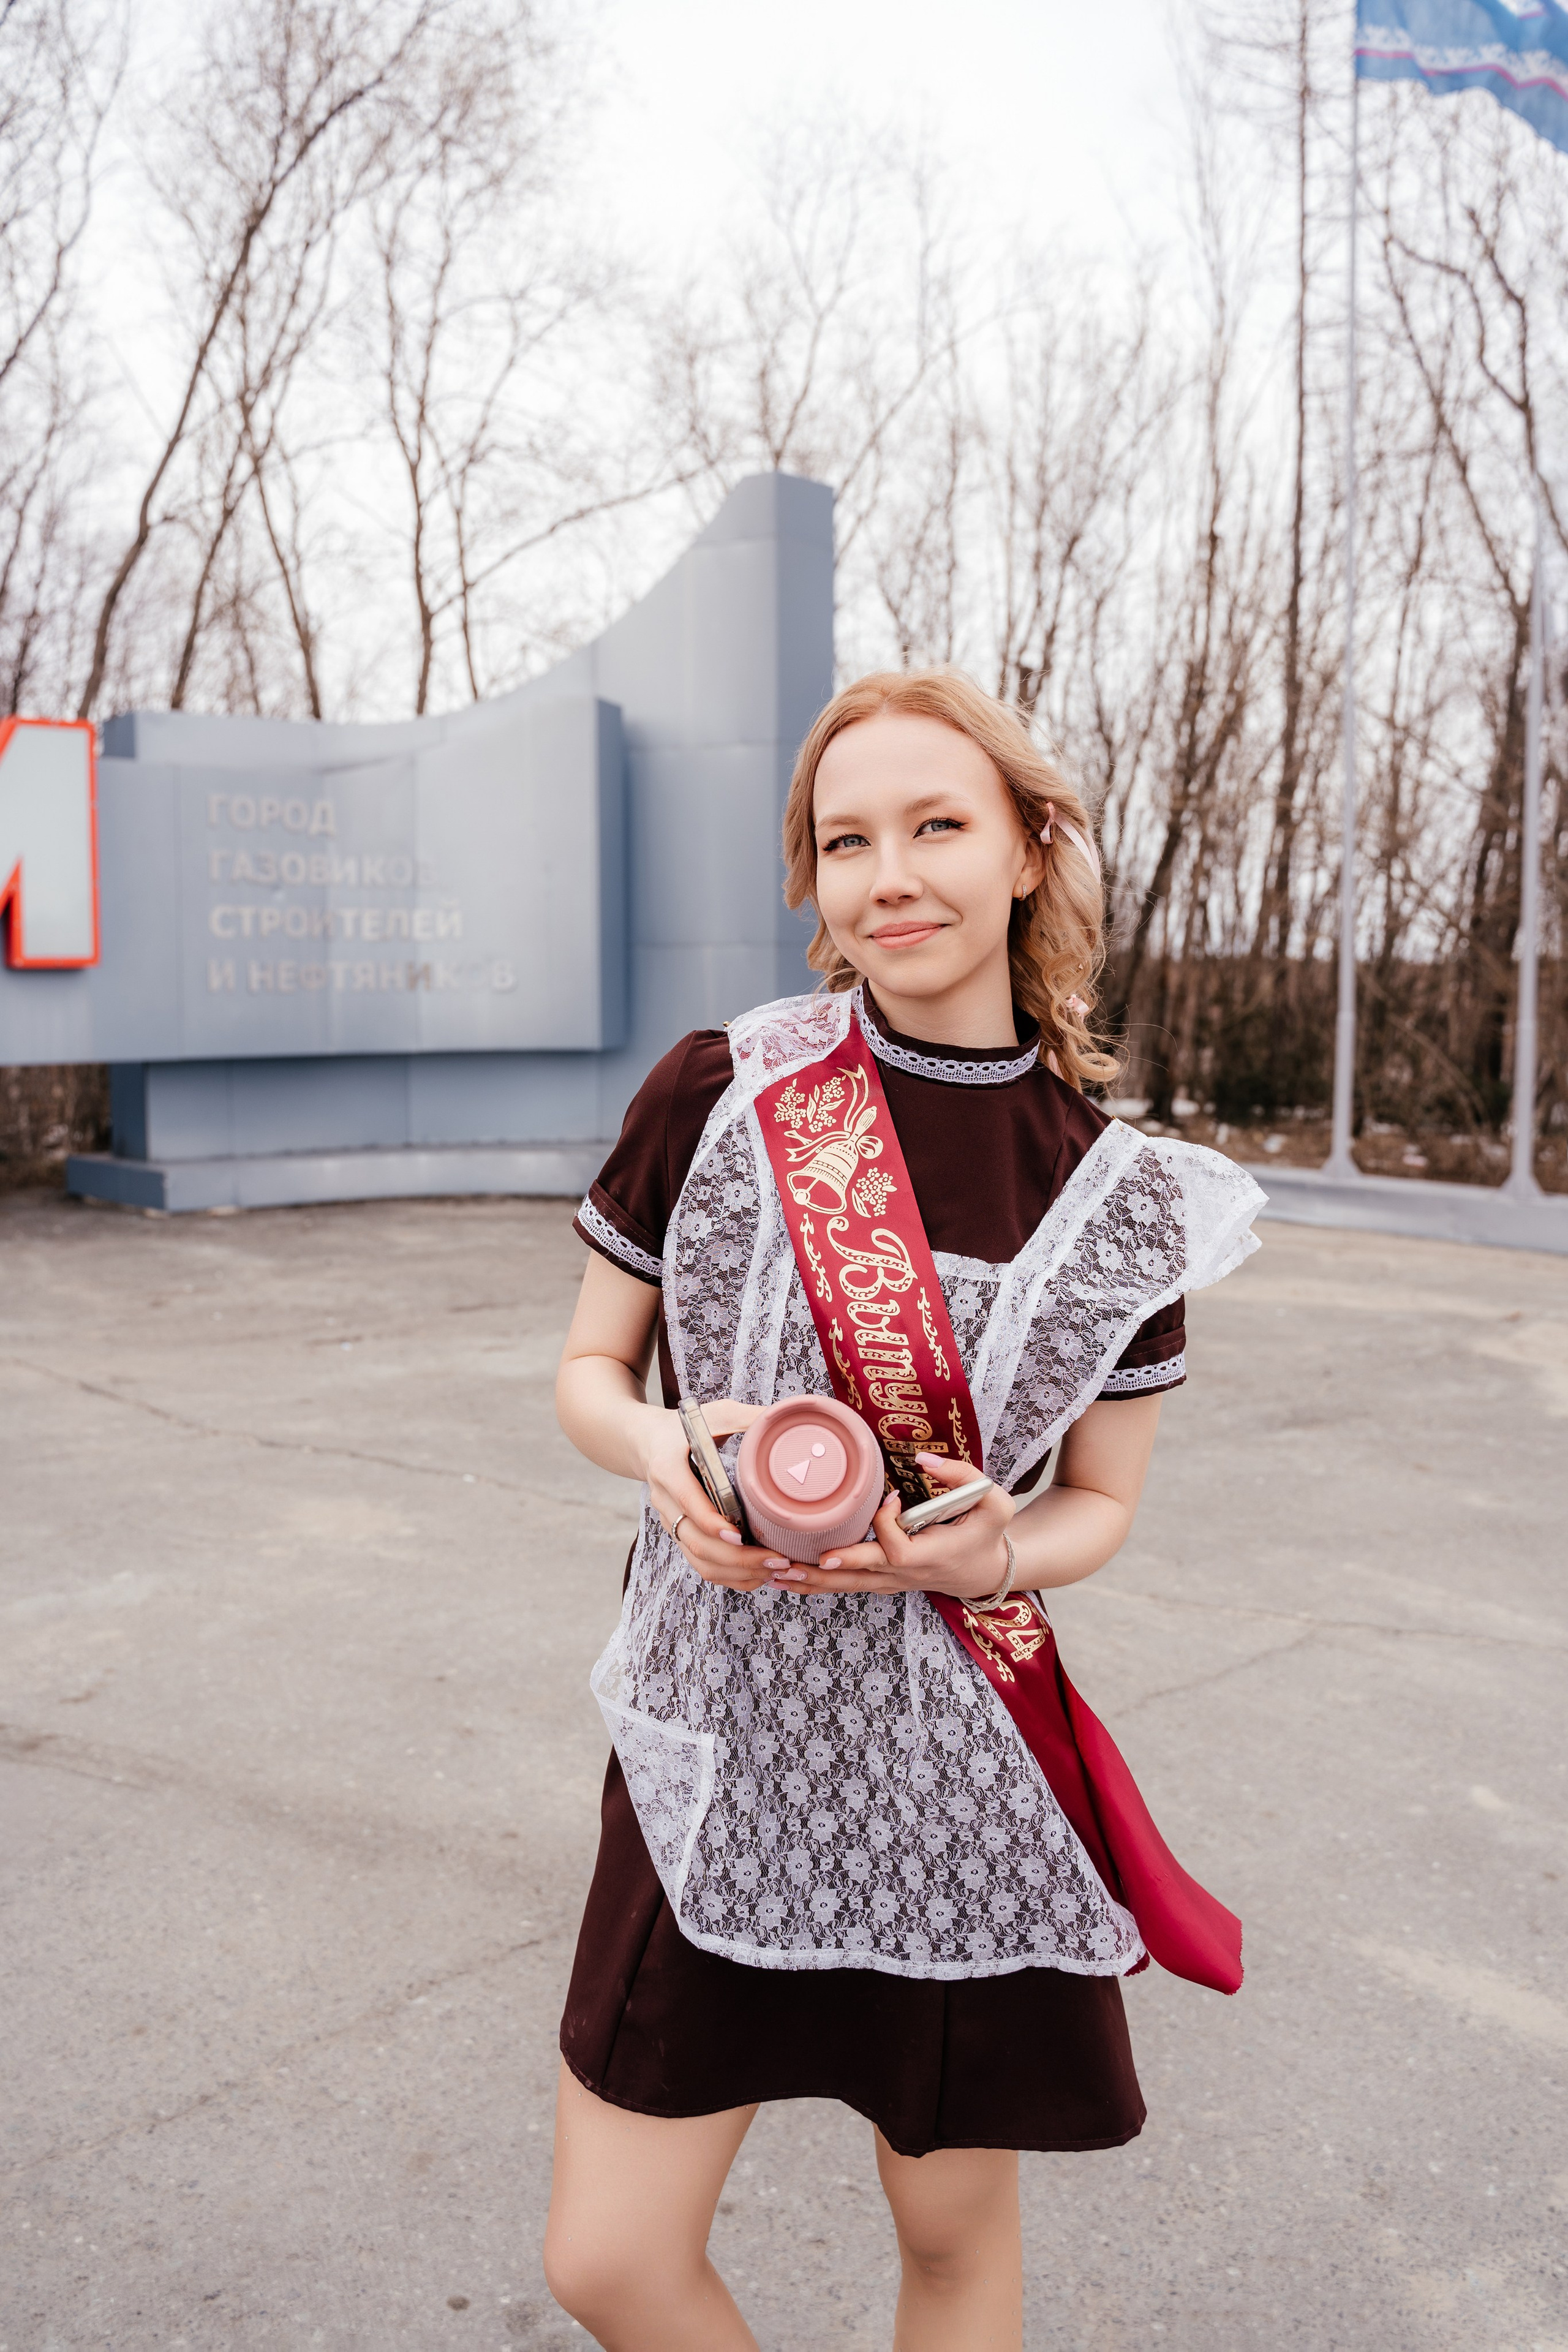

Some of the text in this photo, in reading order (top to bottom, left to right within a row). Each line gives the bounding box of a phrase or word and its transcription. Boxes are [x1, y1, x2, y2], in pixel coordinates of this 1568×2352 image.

[207, 794, 337, 837] ГОРОД
[209, 897, 463, 941] СТРОИТЕЛЕЙ
[207, 959, 235, 992] И
